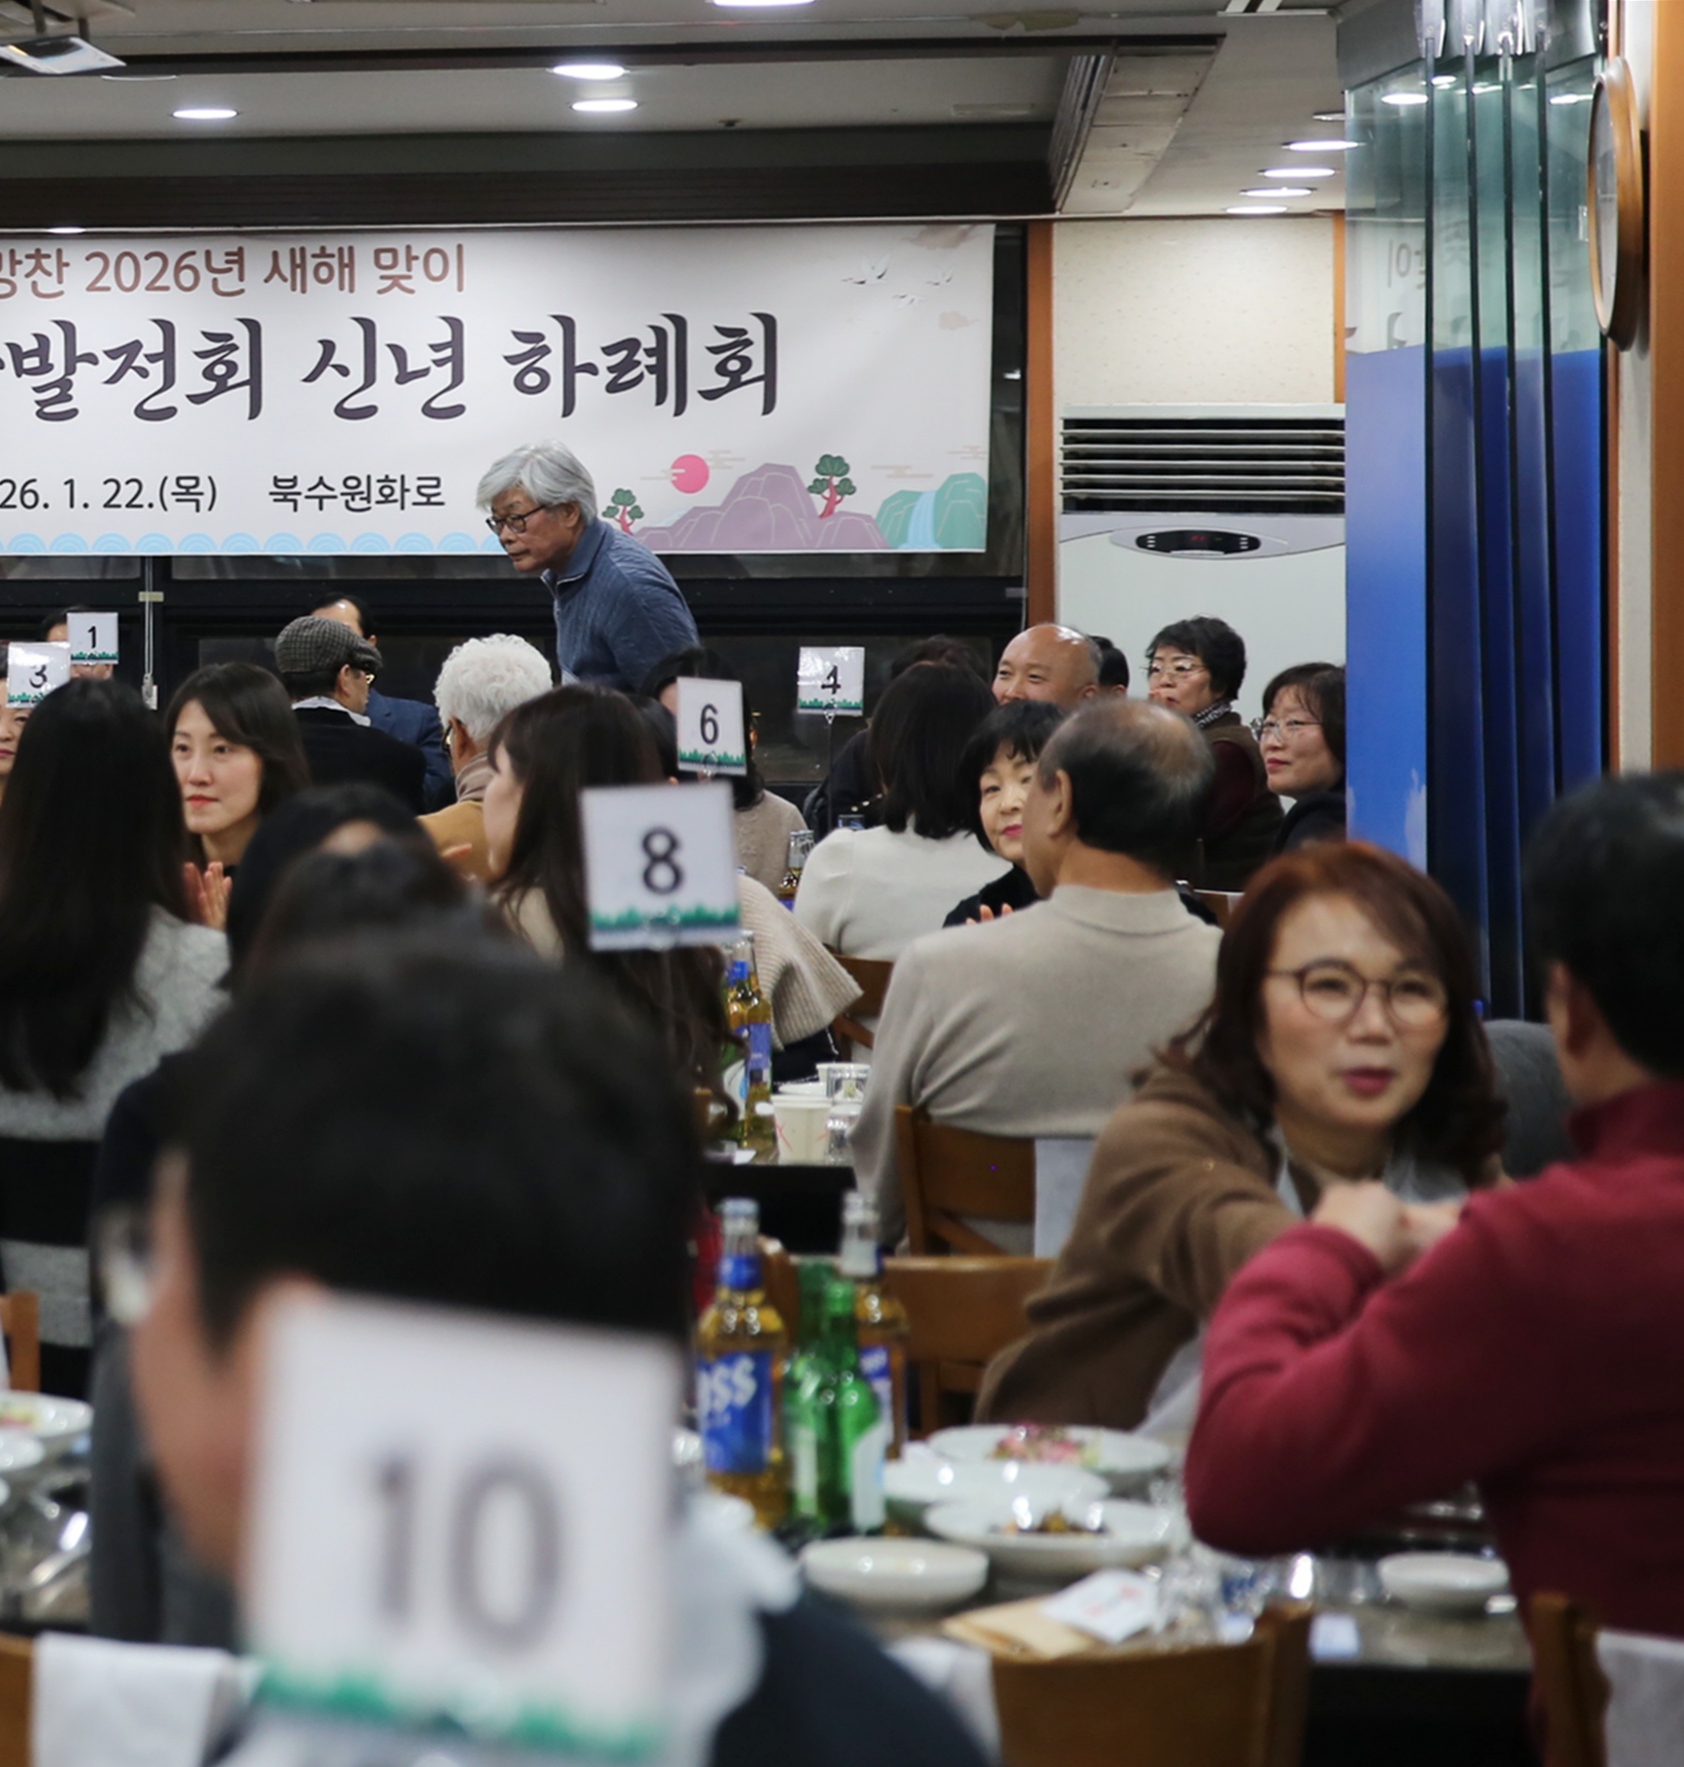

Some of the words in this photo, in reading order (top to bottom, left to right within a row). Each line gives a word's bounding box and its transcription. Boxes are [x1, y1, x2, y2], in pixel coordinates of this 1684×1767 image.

[84, 246, 247, 298] 2026년
[262, 244, 356, 294] 새해
[372, 242, 464, 295] 맞이
[300, 316, 467, 421] 신년
[503, 312, 778, 419] 하례회
[63, 478, 89, 510] 1.
[102, 474, 218, 513] 22.(목)
[268, 474, 446, 513] 북수원화로
[87, 625, 97, 649] 1
[29, 664, 47, 689] 3
[821, 665, 841, 695] 4
[700, 703, 719, 745] 6
[641, 828, 685, 895] 8
[366, 1448, 568, 1658] 10
